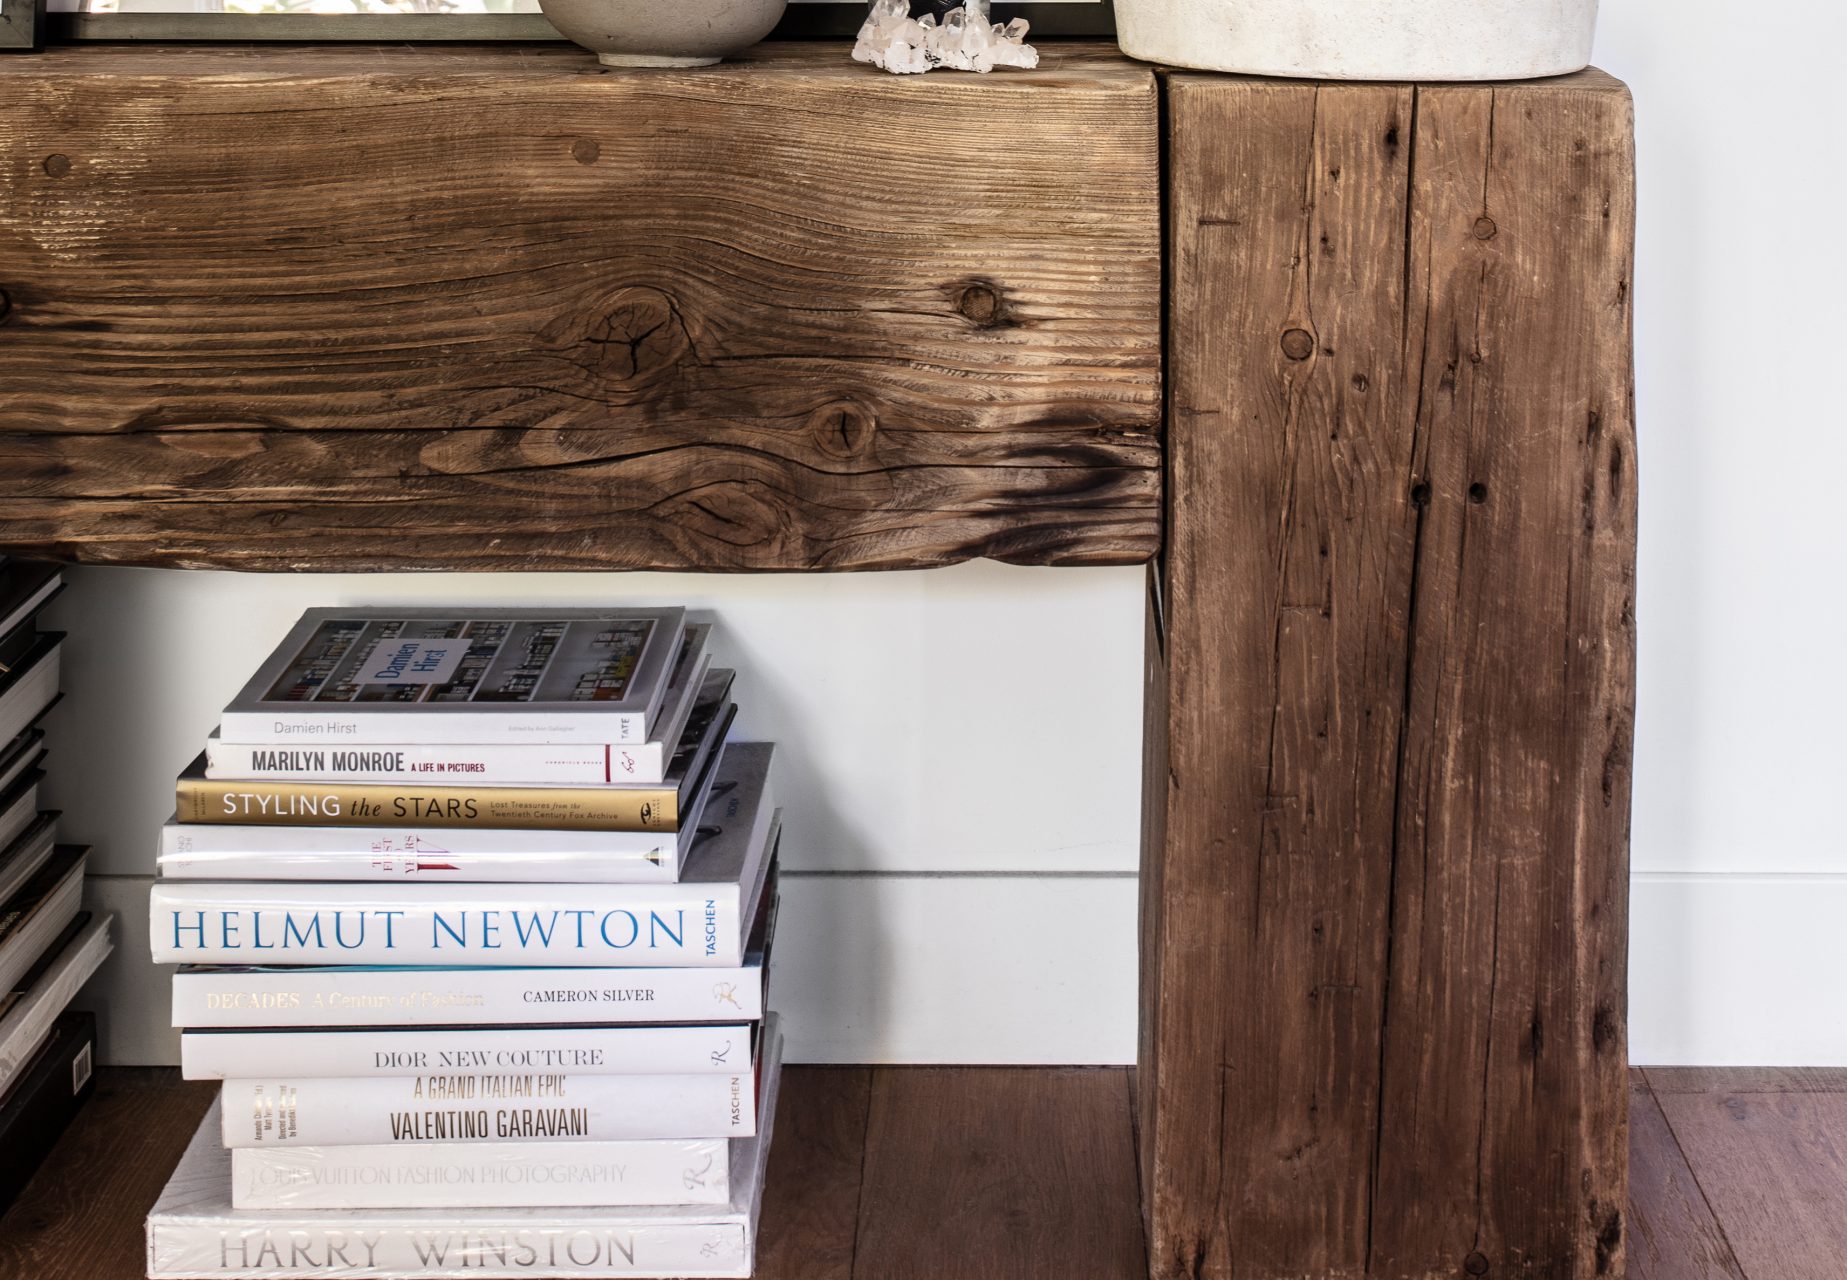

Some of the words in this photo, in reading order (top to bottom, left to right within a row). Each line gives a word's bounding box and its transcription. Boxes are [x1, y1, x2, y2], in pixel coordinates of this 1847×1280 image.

[374, 642, 421, 679] Damien
[410, 648, 448, 672] Hirst
[274, 721, 324, 734] Damien
[327, 721, 357, 734] Hirst
[620, 717, 630, 740] TATE
[252, 750, 325, 772] MARILYN
[332, 751, 405, 773] MONROE
[411, 763, 417, 772] A
[418, 763, 435, 773] LIFE
[437, 763, 445, 773] IN
[447, 763, 486, 773] PICTURES
[223, 792, 341, 817] STYLING
[351, 797, 381, 817] the
[393, 796, 479, 819] STARS
[490, 801, 508, 809] Lost
[511, 801, 550, 810] Treasures
[491, 810, 531, 818] Twentieth
[533, 810, 567, 820] Century
[569, 811, 585, 820] Fox
[587, 811, 619, 820] Archive
[371, 841, 382, 868] TE
[383, 835, 393, 871] FIST
[404, 833, 415, 873] YERS
[171, 911, 405, 949] HELMUT
[431, 909, 687, 949] NEWTON
[705, 899, 716, 957] TASCHEN
[206, 992, 300, 1010] DECADES
[311, 992, 324, 1009] A
[329, 991, 394, 1011] Century
[400, 991, 418, 1008] of
[421, 990, 486, 1008] Fashion
[523, 990, 598, 1003] CAMERON
[603, 989, 655, 1002] SILVER
[375, 1051, 428, 1068] DIOR
[439, 1050, 491, 1068] NEW
[496, 1049, 604, 1067] COUTURE
[414, 1076, 423, 1100] A
[428, 1075, 476, 1100] GRAND
[480, 1074, 532, 1099] ITALIAN
[538, 1074, 566, 1098] EPIC
[732, 1077, 740, 1126] TASCHEN
[390, 1110, 489, 1141] VALENTINO
[496, 1107, 588, 1138] GARAVANI
[311, 1166, 391, 1185] VUITTON
[397, 1165, 474, 1185] FASHION
[481, 1163, 626, 1185] PHOTOGRAPHY
[220, 1229, 388, 1269] HARRY
[405, 1228, 636, 1268] WINSTON
